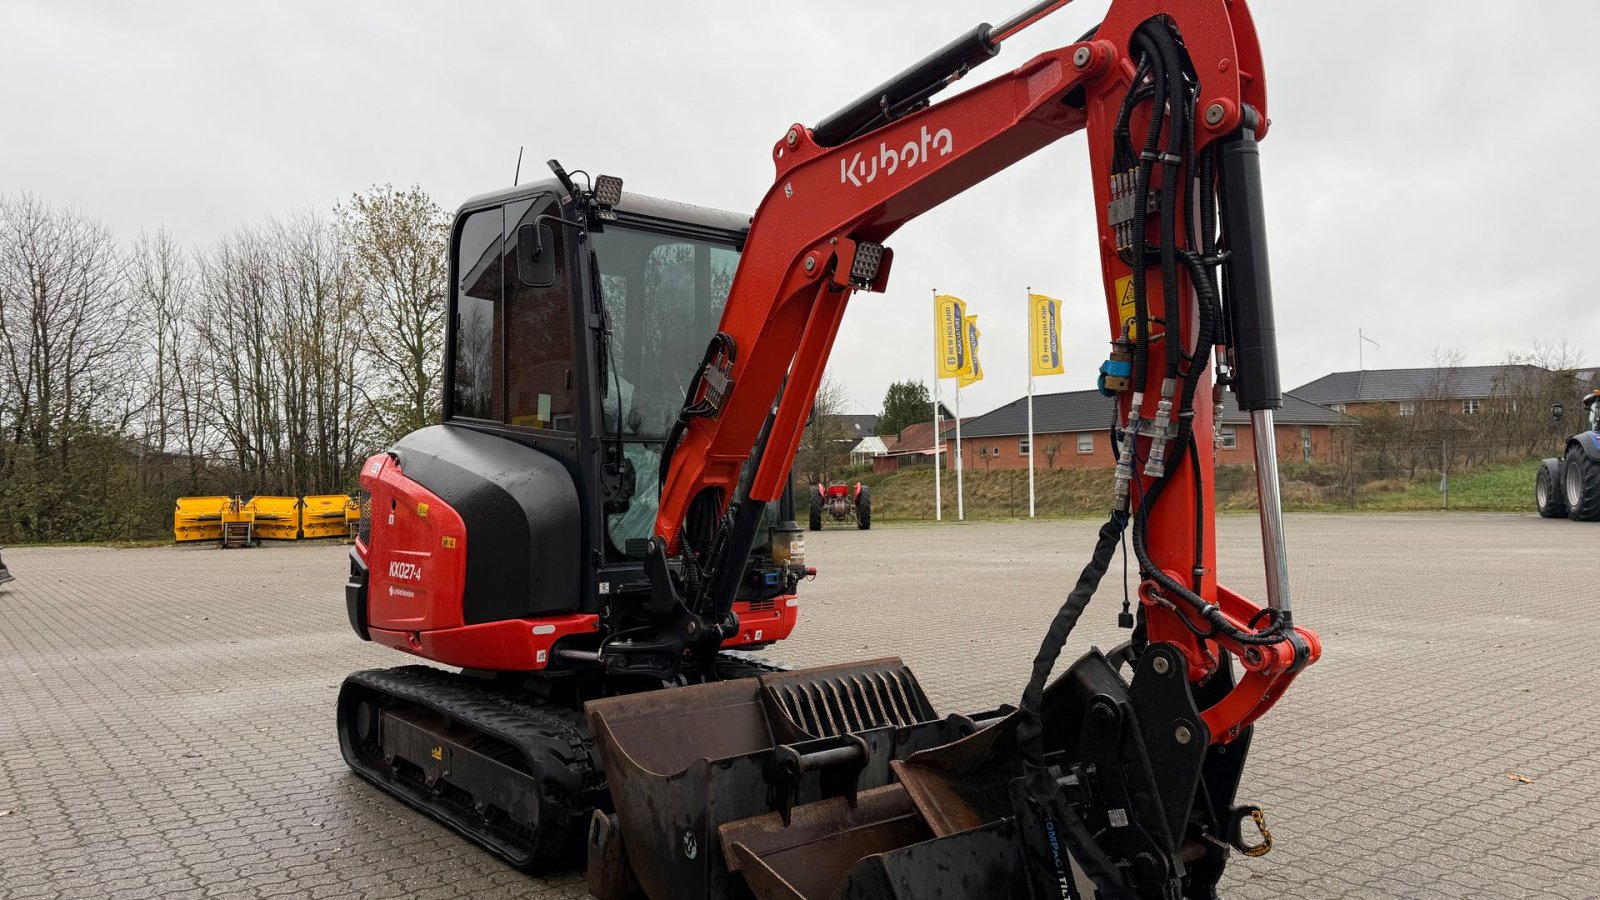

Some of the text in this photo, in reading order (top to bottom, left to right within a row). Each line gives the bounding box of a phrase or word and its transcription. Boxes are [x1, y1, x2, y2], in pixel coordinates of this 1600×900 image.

[840, 125, 953, 188] Kubota
[945, 306, 954, 338] HOLLAND
[954, 317, 963, 355] AGRICULTURE
[389, 561, 421, 581] KX027-4
